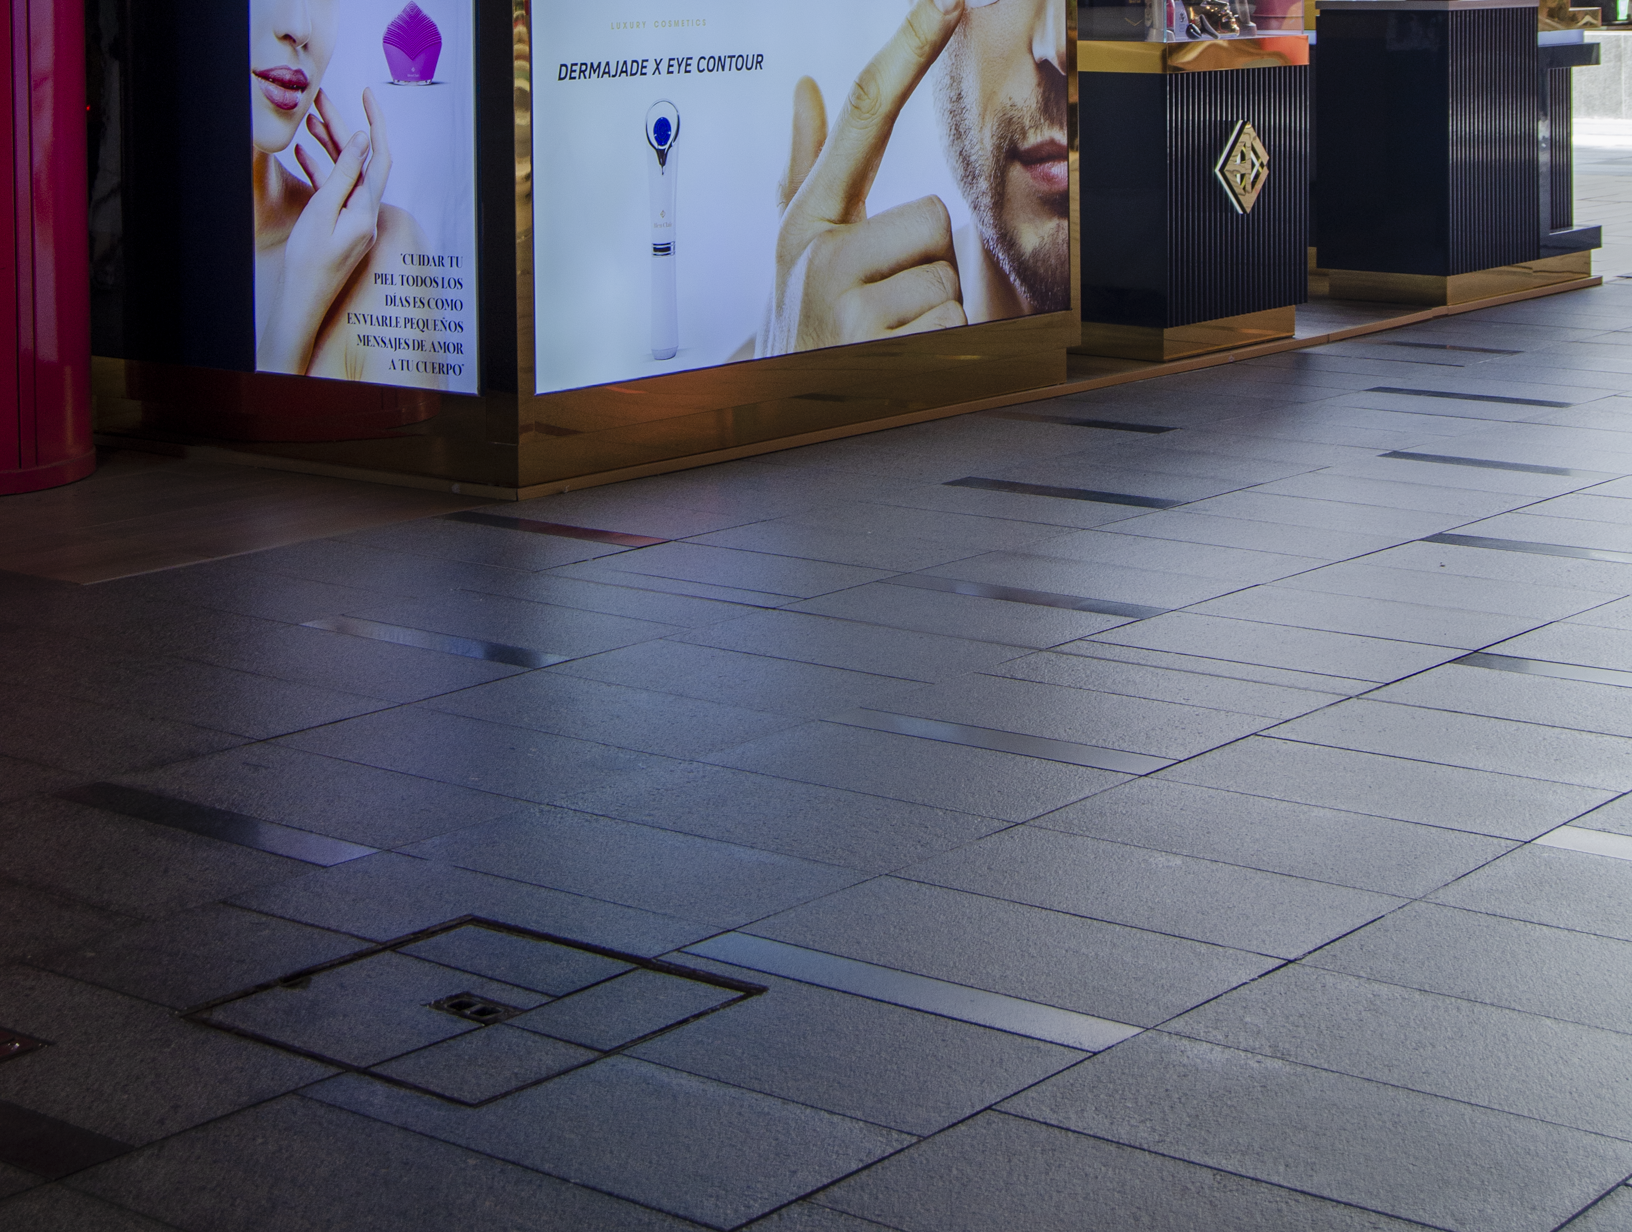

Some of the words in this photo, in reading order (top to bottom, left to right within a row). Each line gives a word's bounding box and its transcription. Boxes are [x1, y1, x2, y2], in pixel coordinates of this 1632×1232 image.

[611, 20, 647, 30] LUXURY
[653, 18, 707, 29] COSMETICS
[557, 58, 649, 81] DERMAJADE
[652, 58, 663, 76] X
[666, 56, 693, 75] EYE
[696, 53, 764, 73] CONTOUR
[447, 255, 463, 268] TU
[374, 272, 397, 286] PIEL
[398, 274, 439, 289] TODOS
[441, 276, 463, 290] LOS
[385, 292, 410, 308] DÍAS
[413, 296, 425, 309] ES
[427, 297, 463, 312] COMO
[347, 312, 401, 329] ENVIARLE
[403, 317, 464, 333] PEQUEÑOS
[356, 334, 410, 352] MENSAJES
[412, 339, 427, 352] DE
[429, 340, 464, 355] AMOR
[388, 358, 397, 371] A
[398, 359, 413, 372] TU
